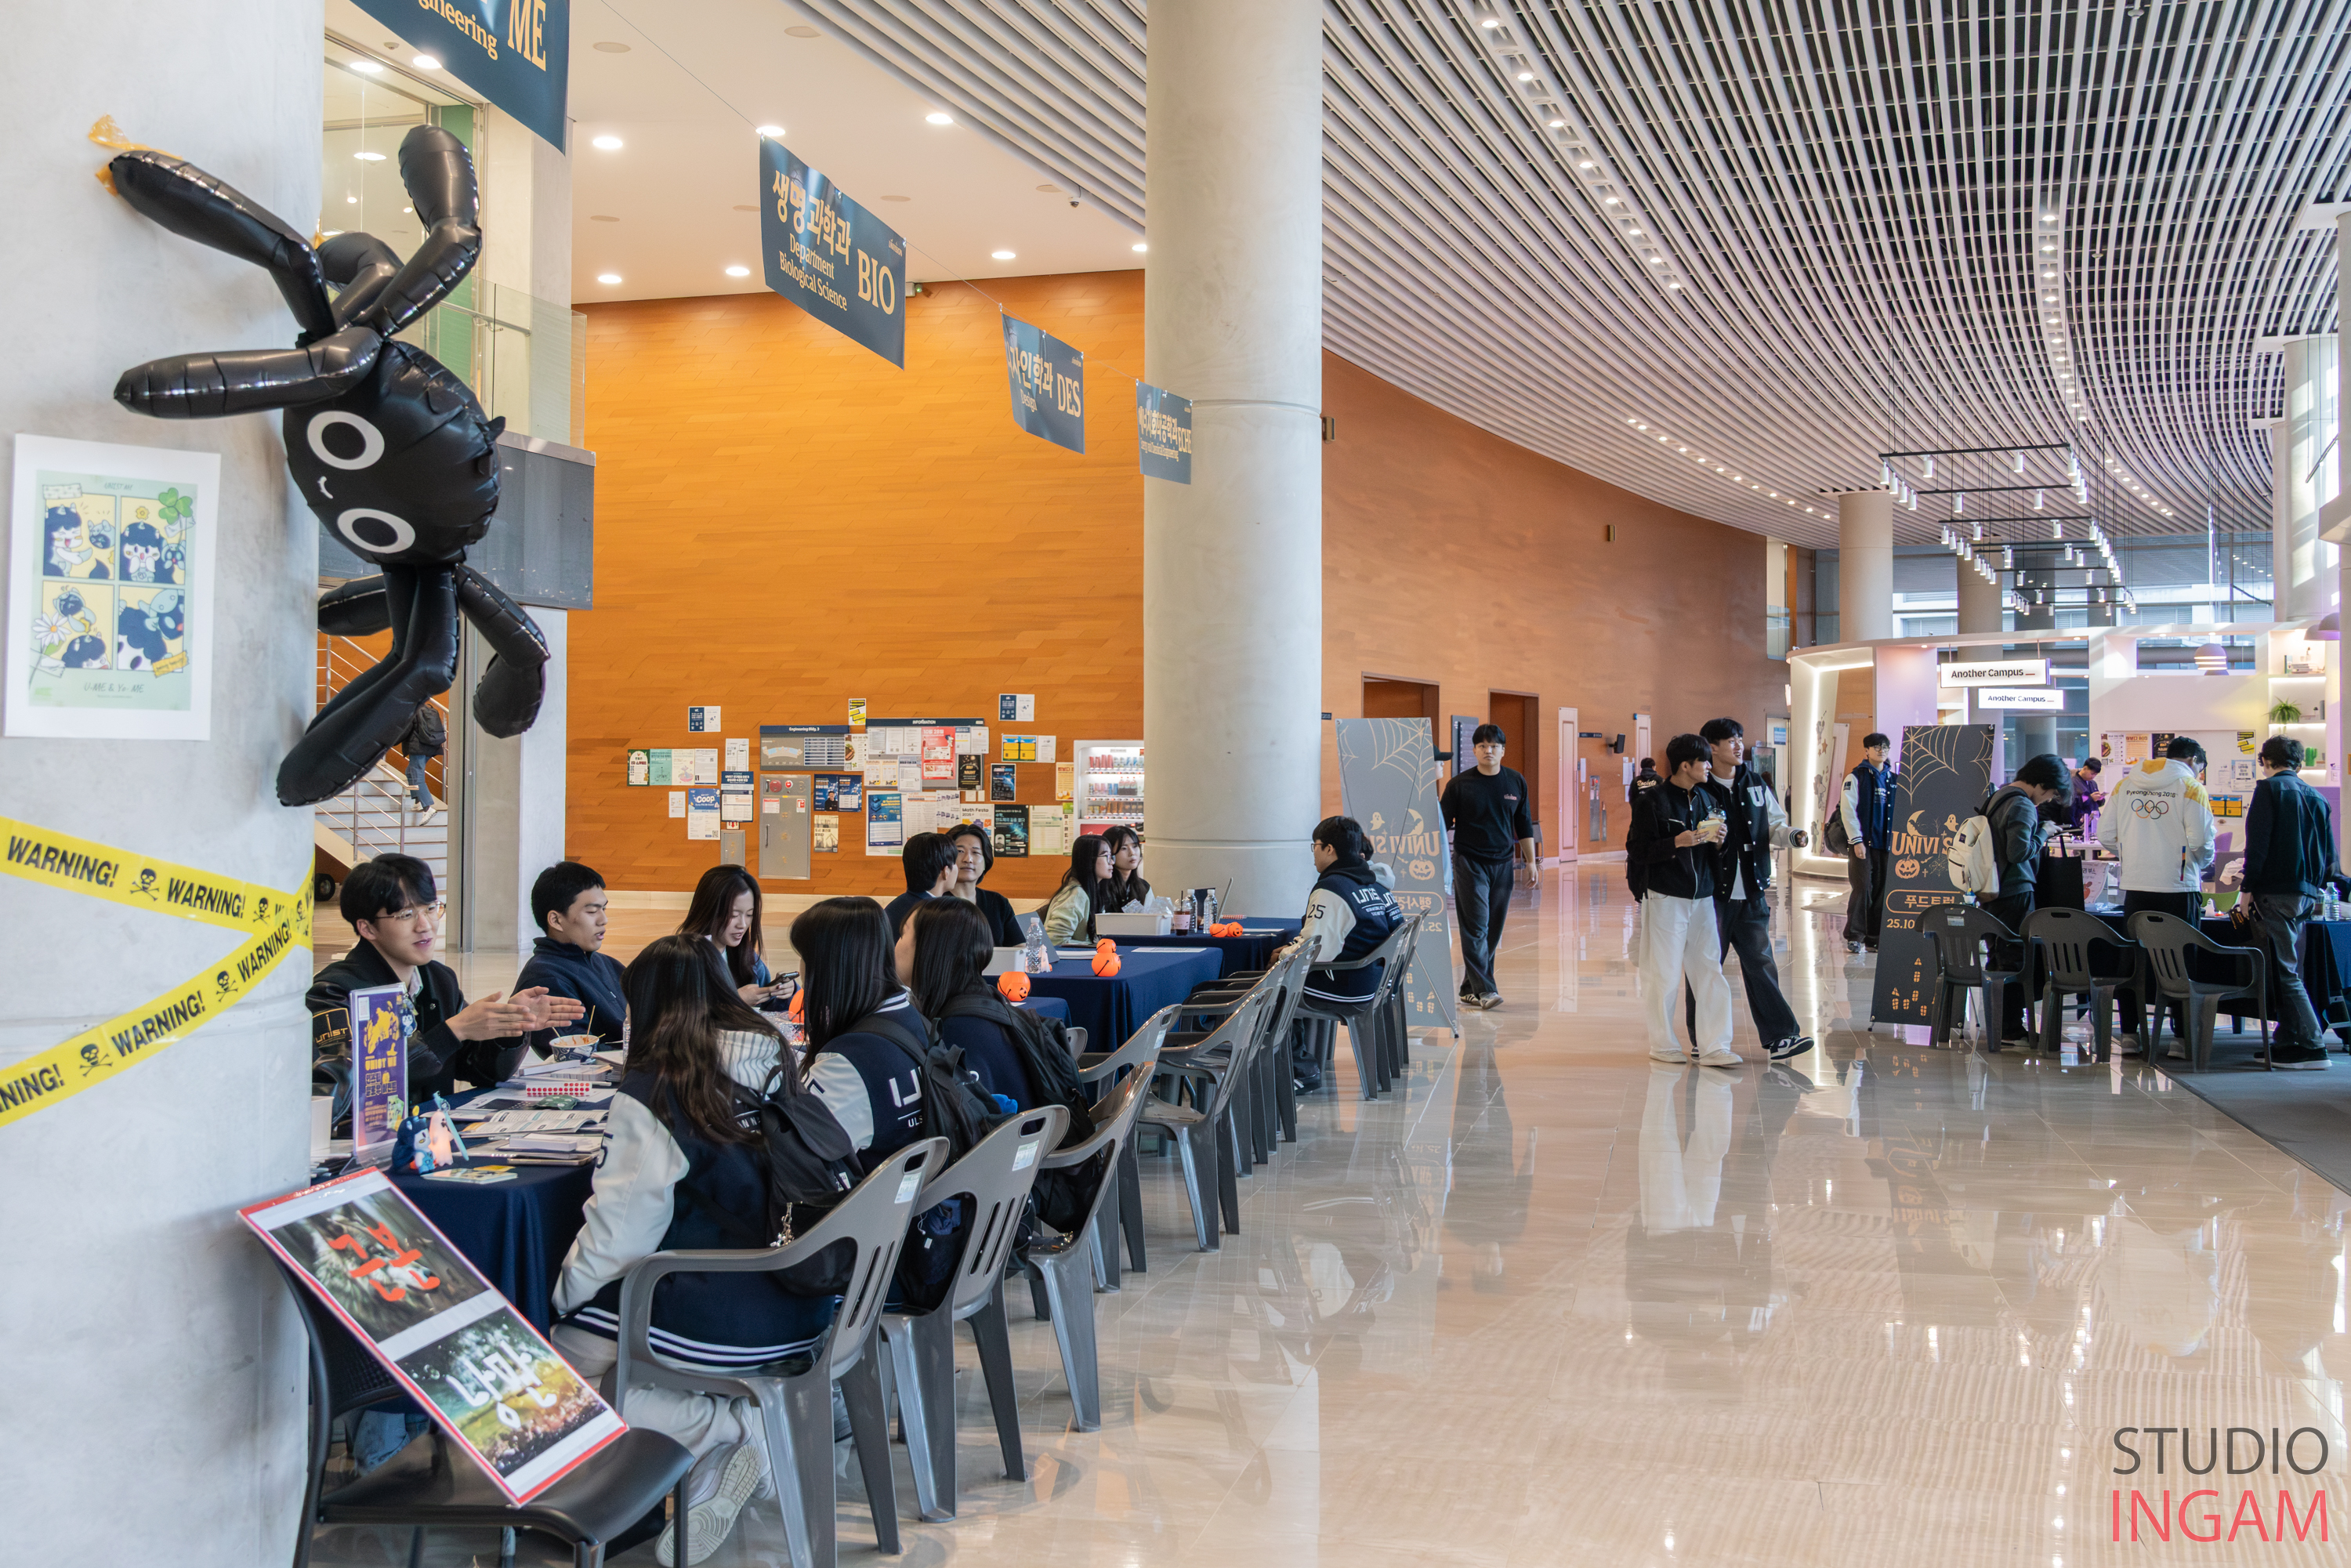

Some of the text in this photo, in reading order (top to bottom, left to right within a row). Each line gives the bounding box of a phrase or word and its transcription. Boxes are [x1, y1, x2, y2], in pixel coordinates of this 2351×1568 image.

[508, 0, 546, 71] ME
[772, 170, 851, 266] 생명과학과
[779, 250, 848, 312] Biological Science
[789, 233, 835, 281] Department
[857, 248, 895, 315] BIO
[1020, 388, 1038, 413] Design
[1057, 372, 1081, 418] DES
[1951, 668, 2024, 679] Another Campus
[696, 795, 715, 804] Coop
[1746, 785, 1765, 807] U
[7, 835, 120, 889] WARNING!
[1891, 831, 1940, 857] UNIVI
[166, 877, 247, 919] WARNING!
[1307, 904, 1327, 920] 25
[237, 918, 293, 983] WARNING!
[111, 989, 207, 1058] WARNING!
[0, 1063, 66, 1115] NING!
[446, 1339, 558, 1429] 낭만
